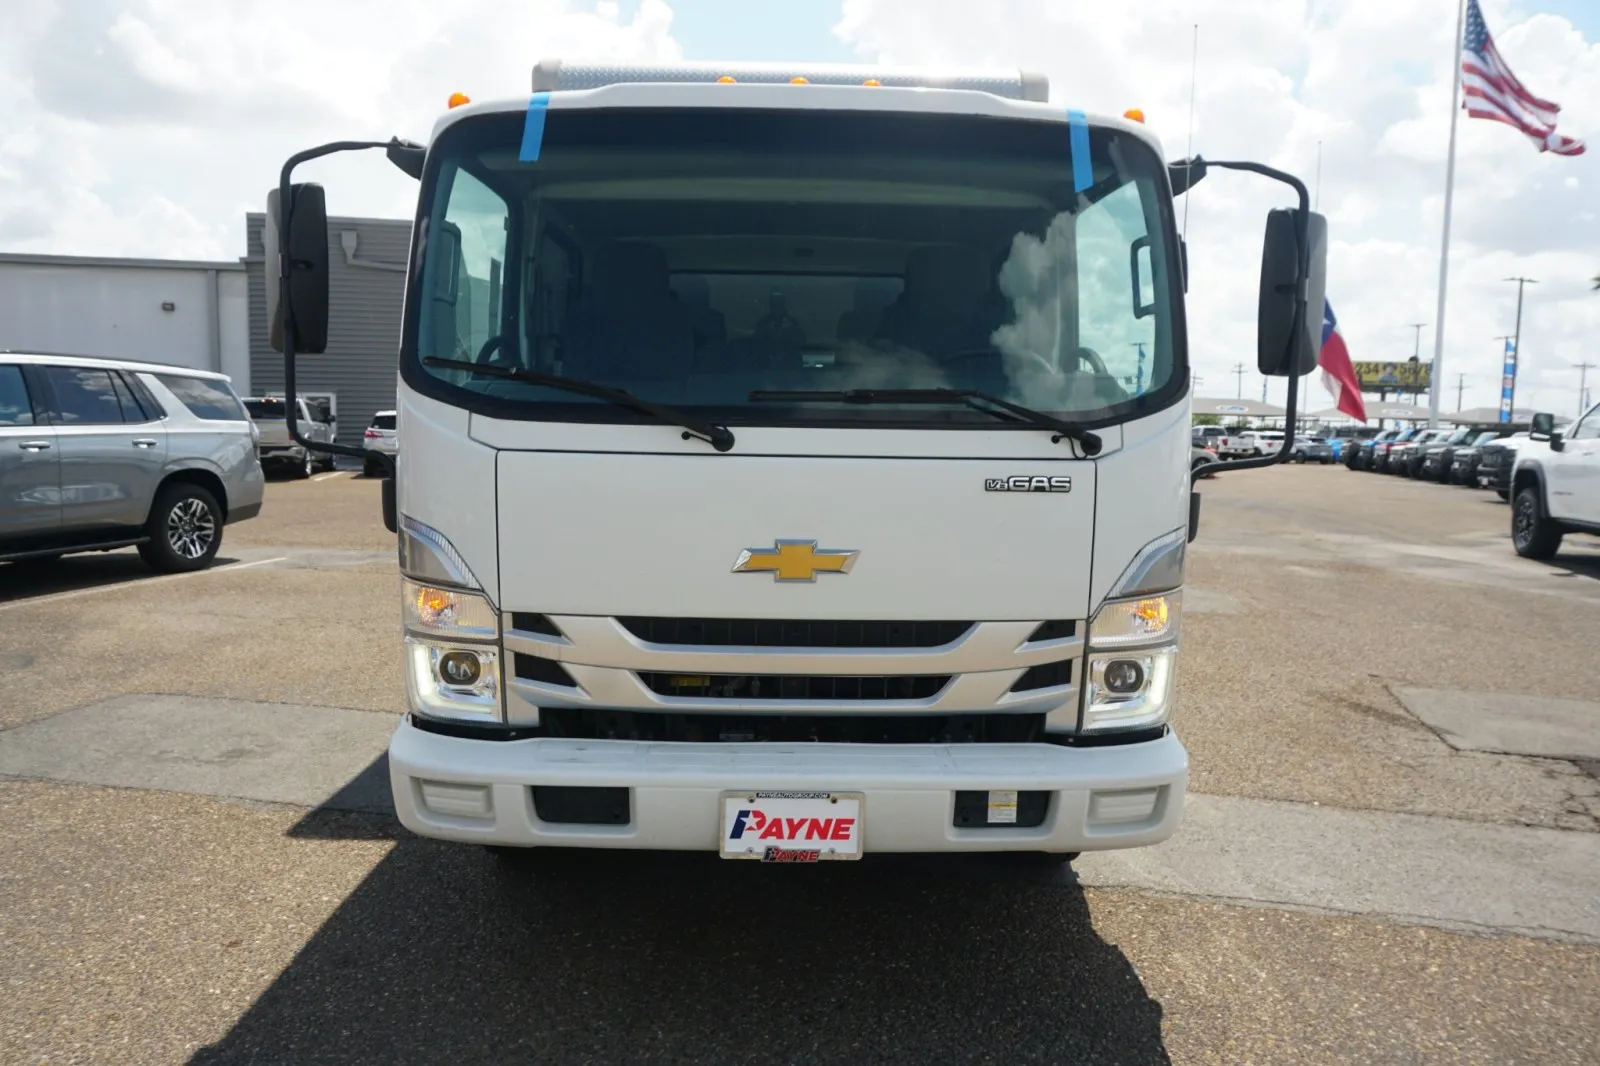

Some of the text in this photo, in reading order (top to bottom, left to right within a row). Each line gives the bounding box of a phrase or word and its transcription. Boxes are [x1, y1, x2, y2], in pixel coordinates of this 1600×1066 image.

[1008, 476, 1071, 492] GAS
[730, 810, 855, 840] PAYNE
[763, 847, 819, 861] PAYNE
